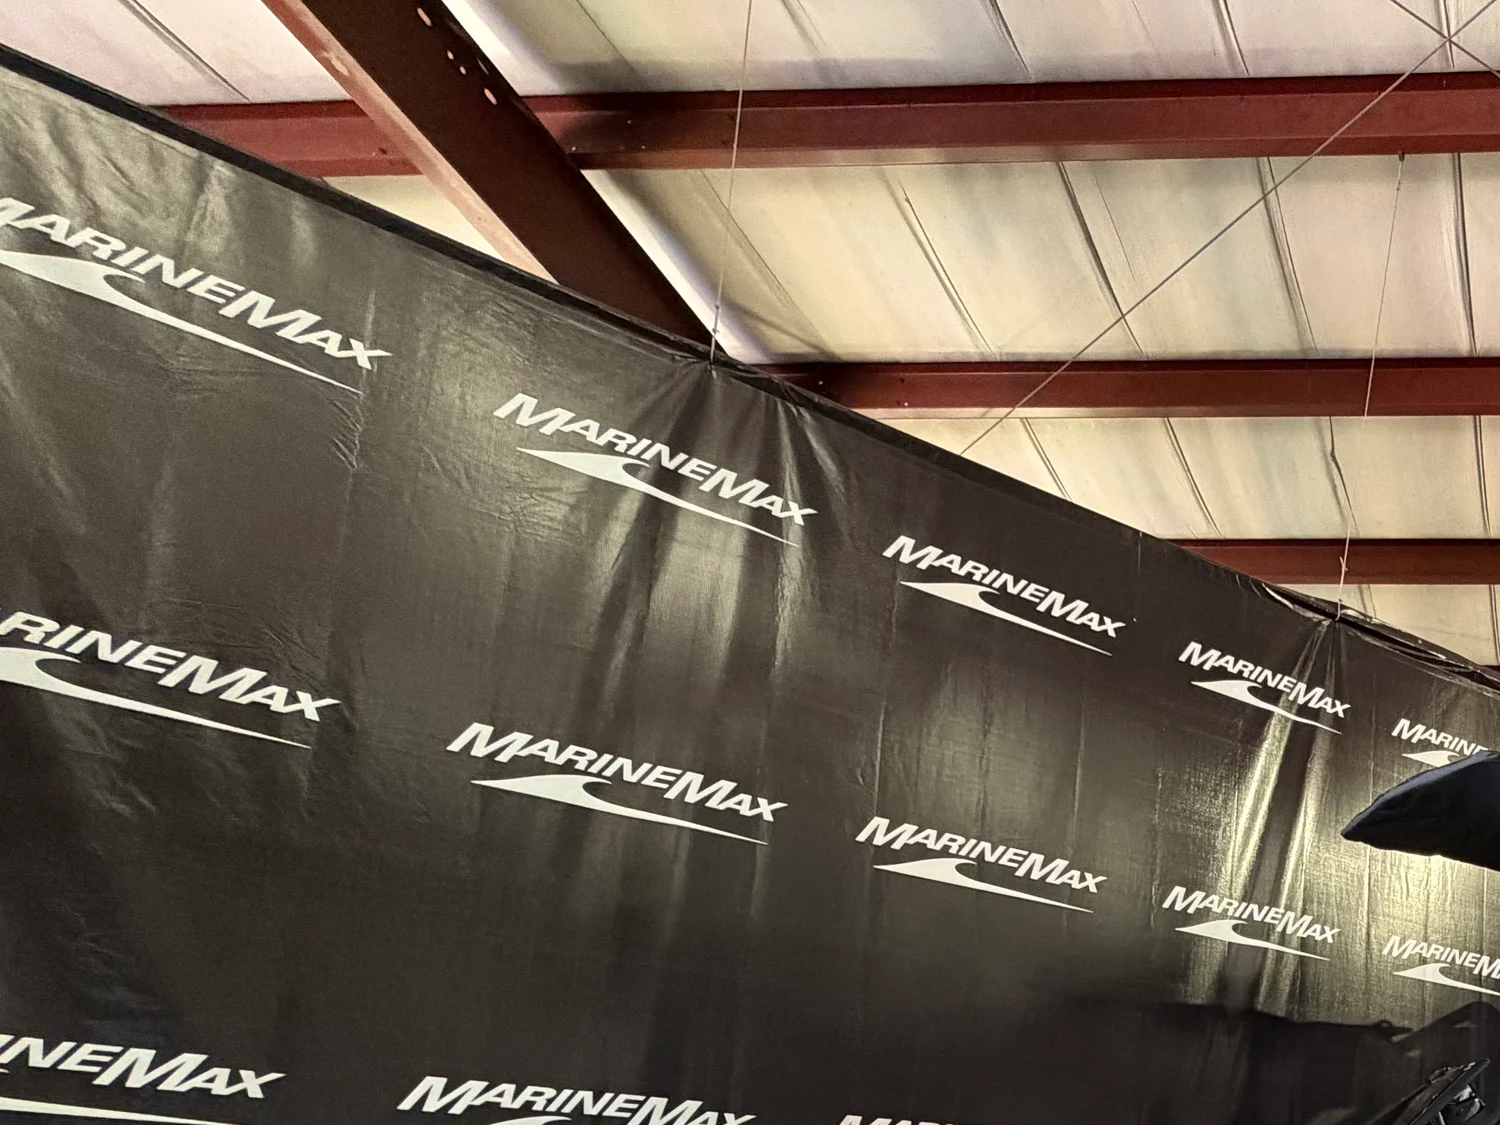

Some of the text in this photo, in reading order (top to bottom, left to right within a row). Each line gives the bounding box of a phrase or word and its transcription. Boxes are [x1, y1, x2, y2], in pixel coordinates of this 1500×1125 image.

[494, 393, 818, 527] MARINEMAX
[883, 535, 1127, 639] MARINEMAX
[0, 611, 341, 724] RINEMAX
[1178, 641, 1352, 719] MARINEMAX
[446, 722, 788, 824] MARINEMAX
[855, 816, 1107, 895] MARINEMAX
[1162, 885, 1341, 945] MARINEMAX
